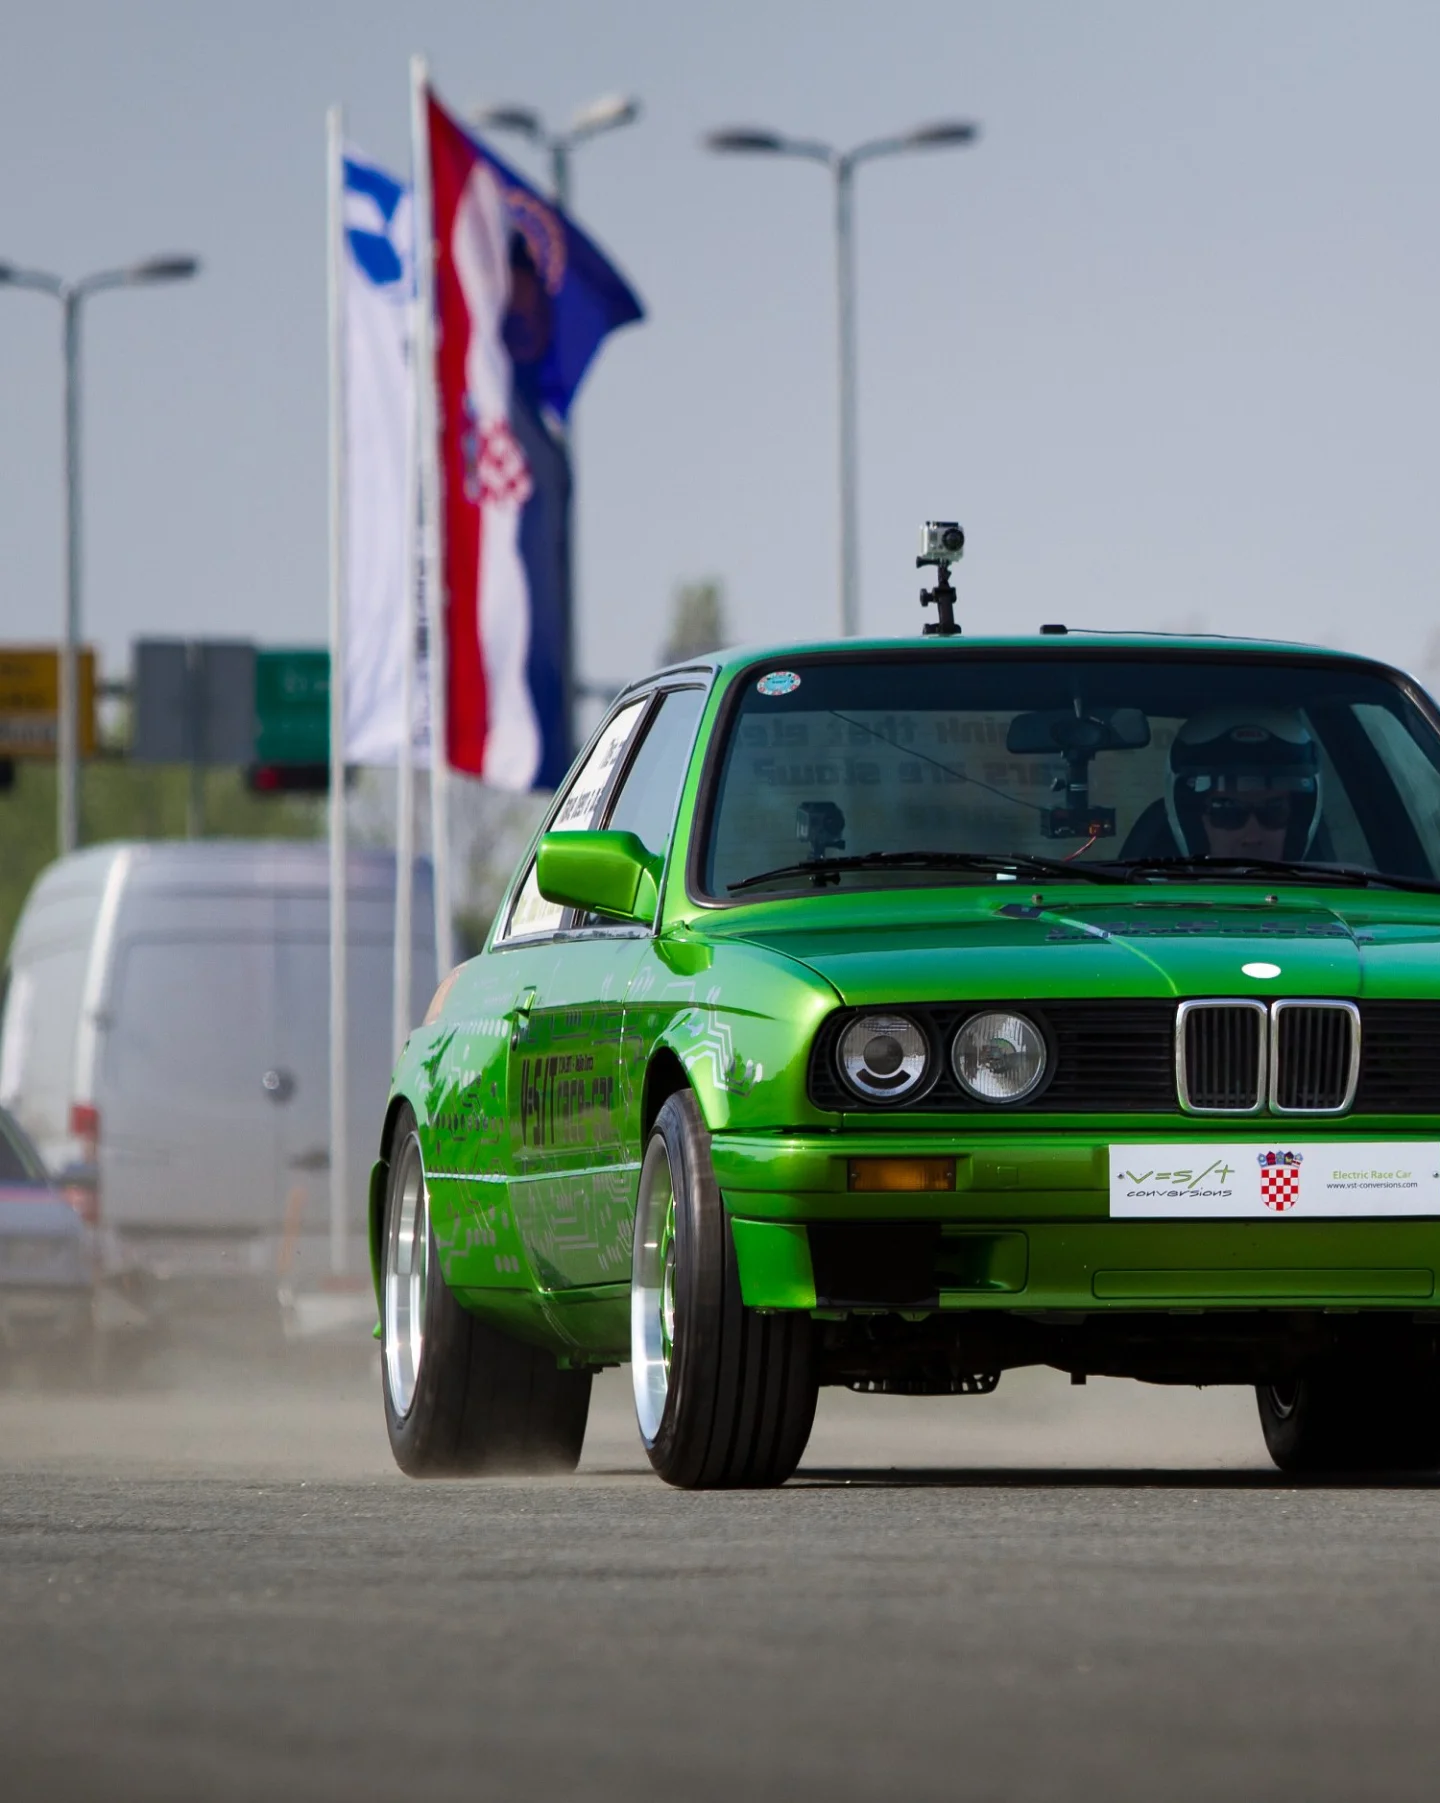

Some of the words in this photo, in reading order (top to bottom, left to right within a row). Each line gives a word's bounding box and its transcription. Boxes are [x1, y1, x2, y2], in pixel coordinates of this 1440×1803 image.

[1333, 1170, 1368, 1179] Electric
[1371, 1170, 1393, 1179] Race
[1396, 1169, 1412, 1179] Car
[1326, 1181, 1418, 1190] www.vst-conversions.com
[1126, 1187, 1233, 1197] conversions
